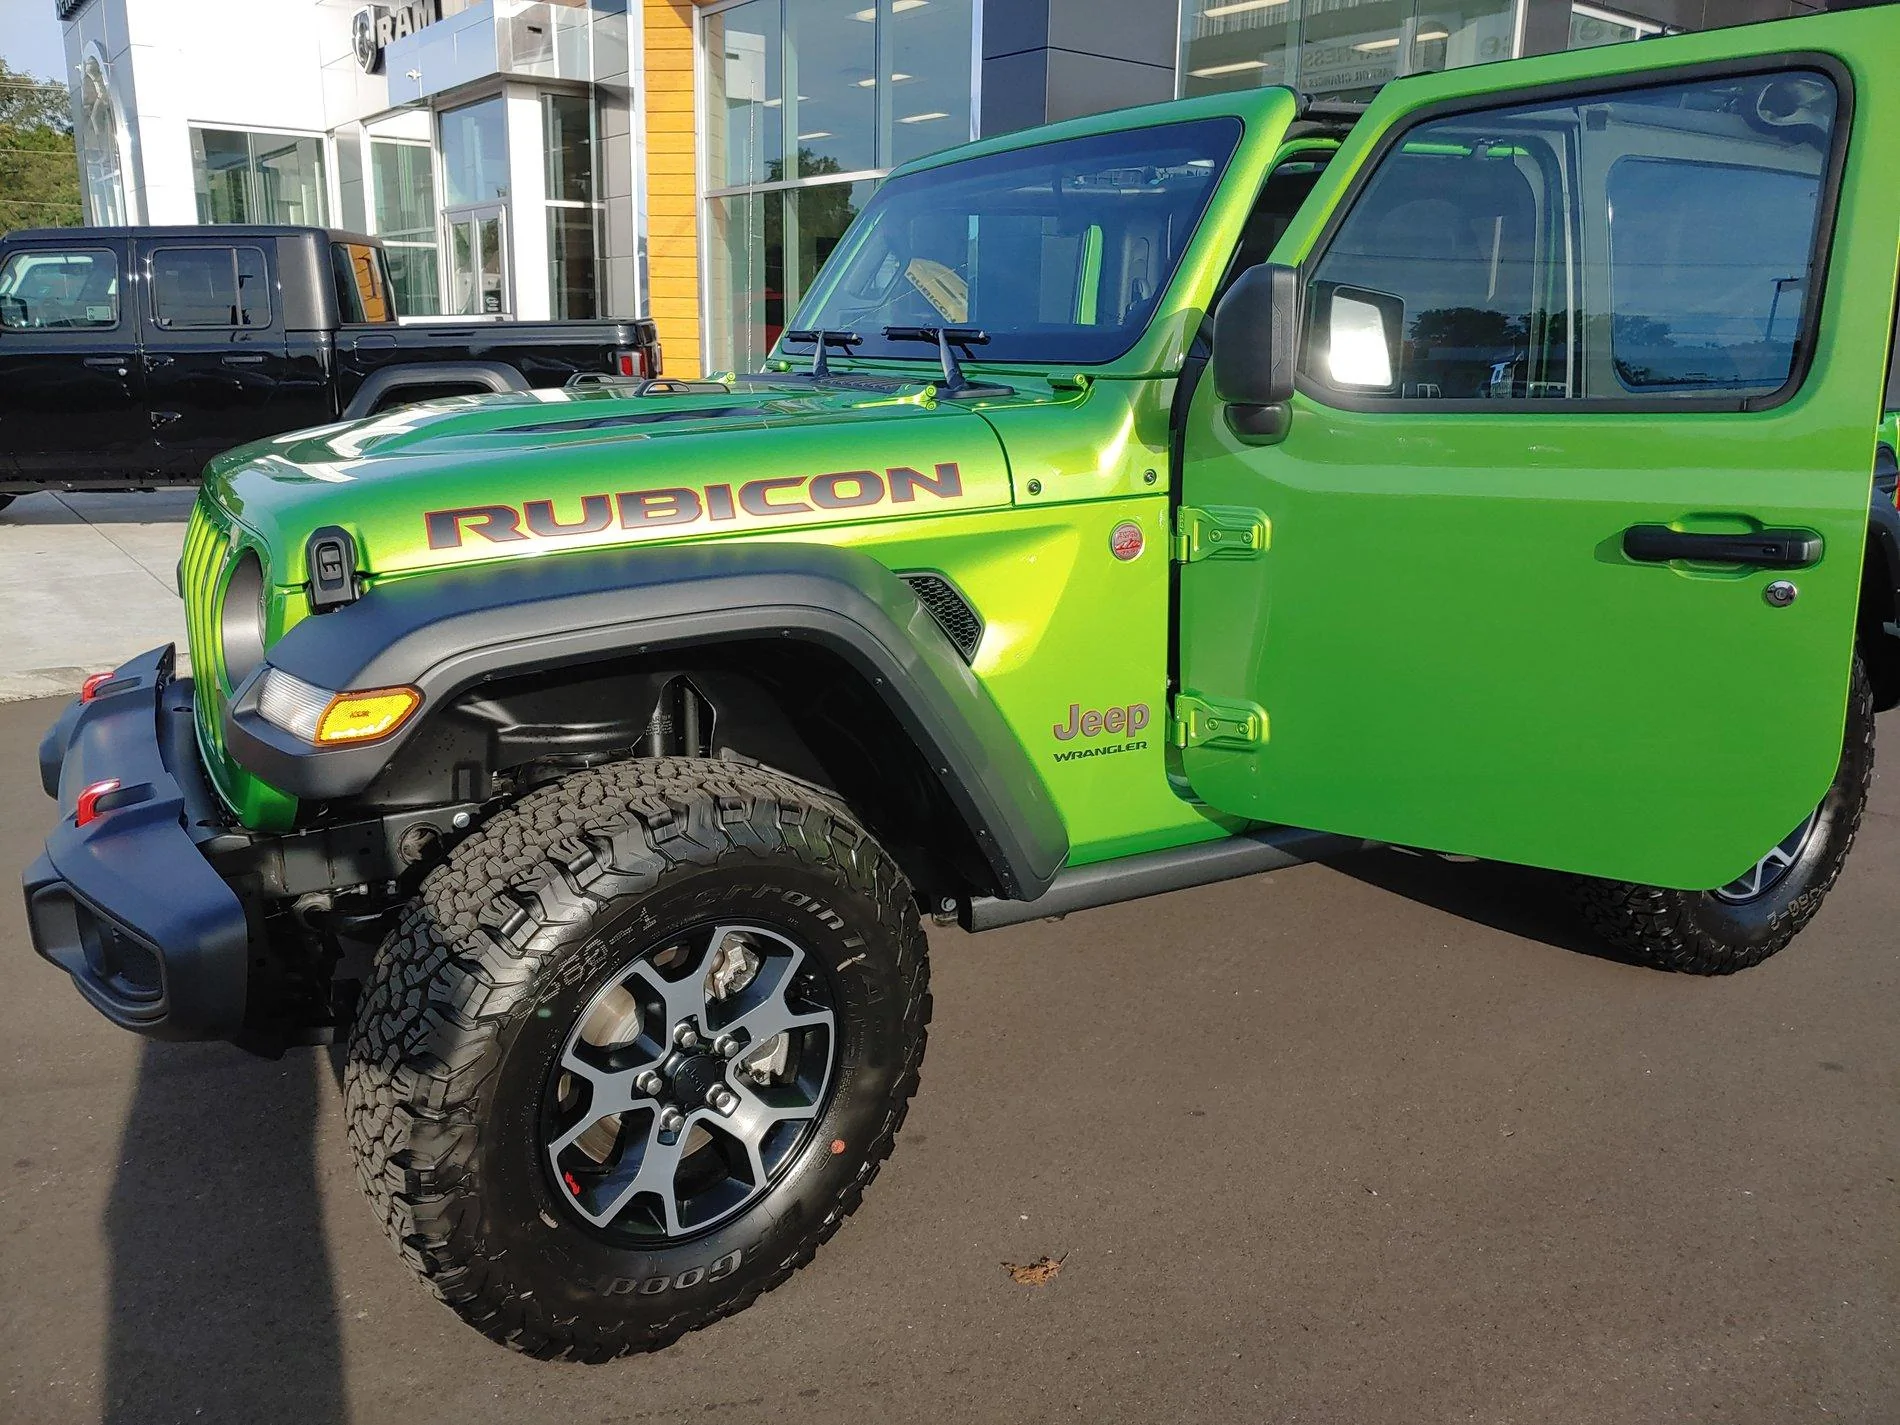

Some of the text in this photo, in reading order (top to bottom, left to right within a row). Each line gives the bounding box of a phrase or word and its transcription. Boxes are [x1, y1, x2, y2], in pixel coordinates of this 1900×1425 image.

[377, 0, 437, 49] RAM
[423, 462, 962, 550] RUBICON
[1053, 702, 1150, 741] Jeep
[1053, 740, 1148, 763] WRANGLER
